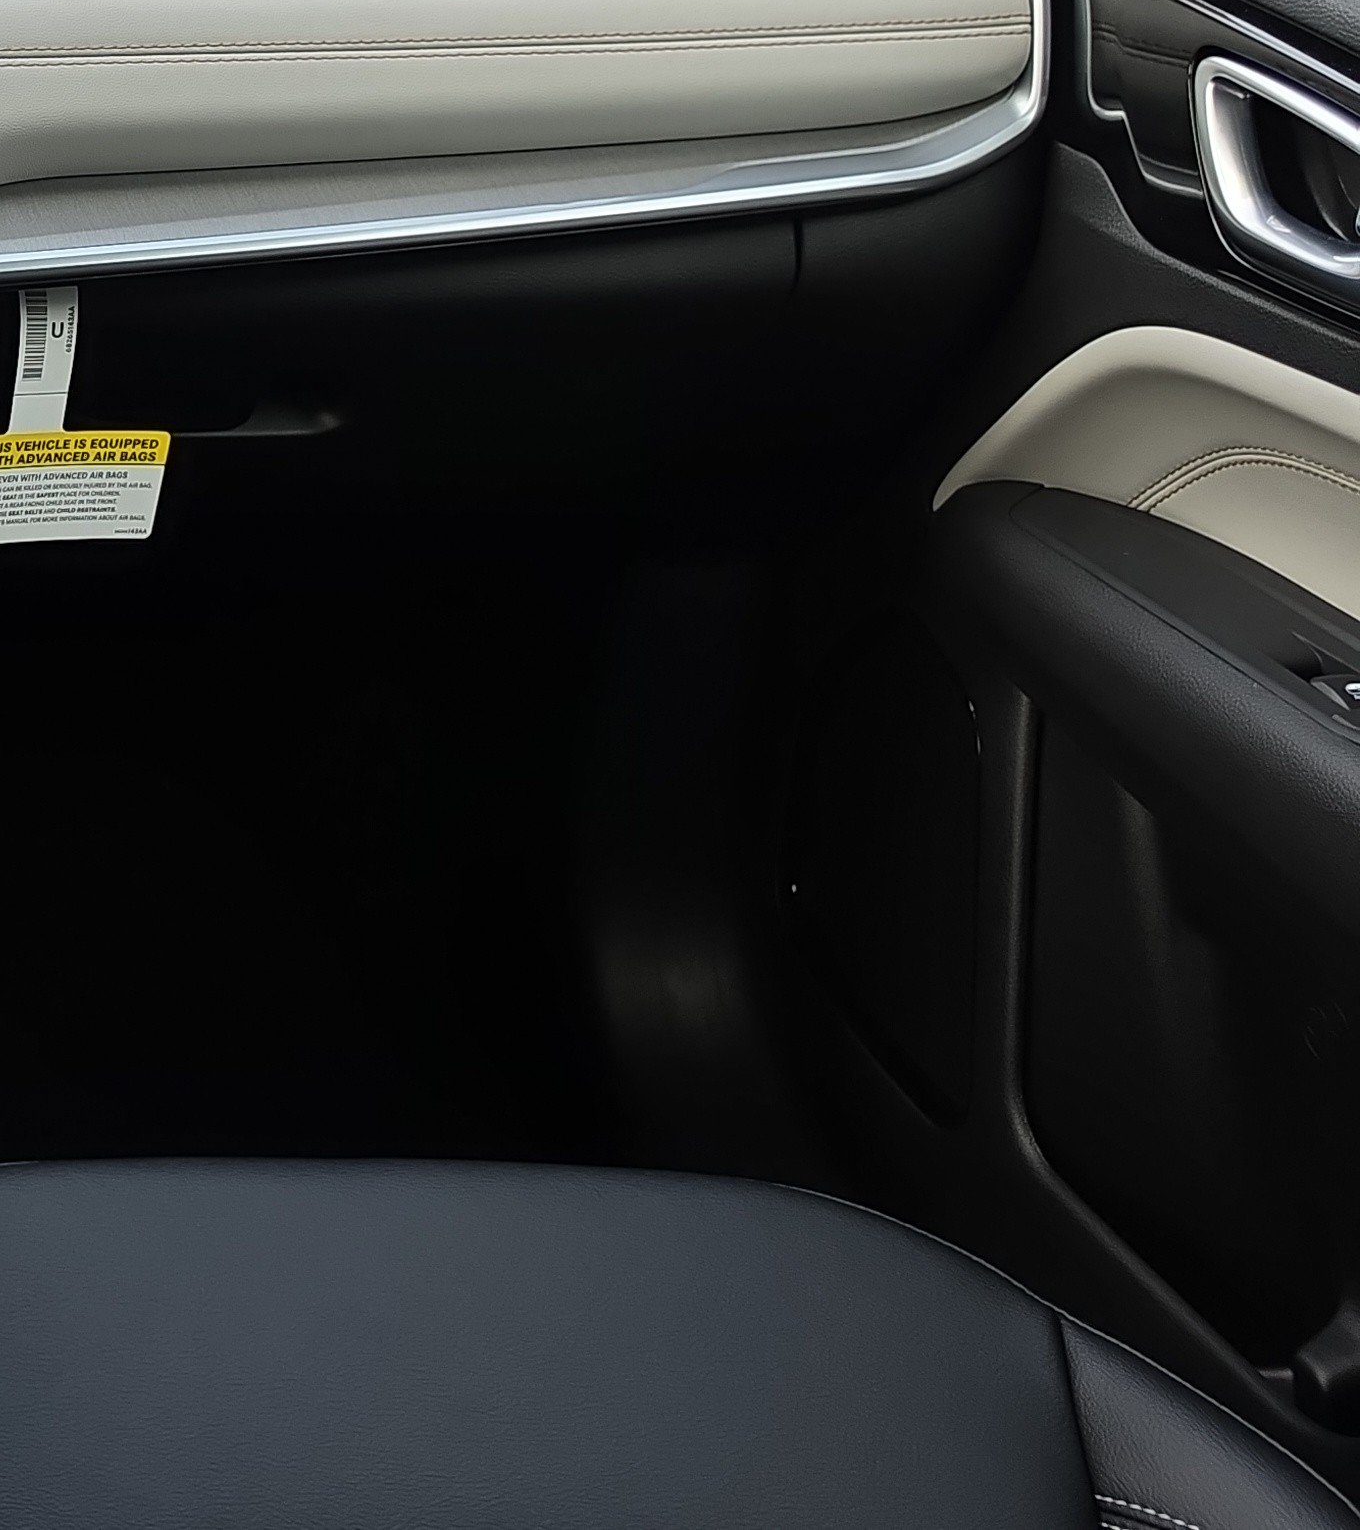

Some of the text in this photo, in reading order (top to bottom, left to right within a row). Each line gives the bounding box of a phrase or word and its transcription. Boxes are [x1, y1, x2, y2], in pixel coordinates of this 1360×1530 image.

[51, 322, 64, 338] U
[15, 439, 71, 452] VEHICLE
[74, 439, 87, 449] IS
[90, 438, 160, 449] EQUIPPED
[16, 451, 90, 465] ADVANCED
[92, 451, 117, 462] AIR
[119, 451, 157, 462] BAGS
[20, 473, 41, 482] WITH
[43, 471, 88, 481] ADVANCED
[89, 471, 104, 479] AIR
[105, 471, 129, 479] BAGS
